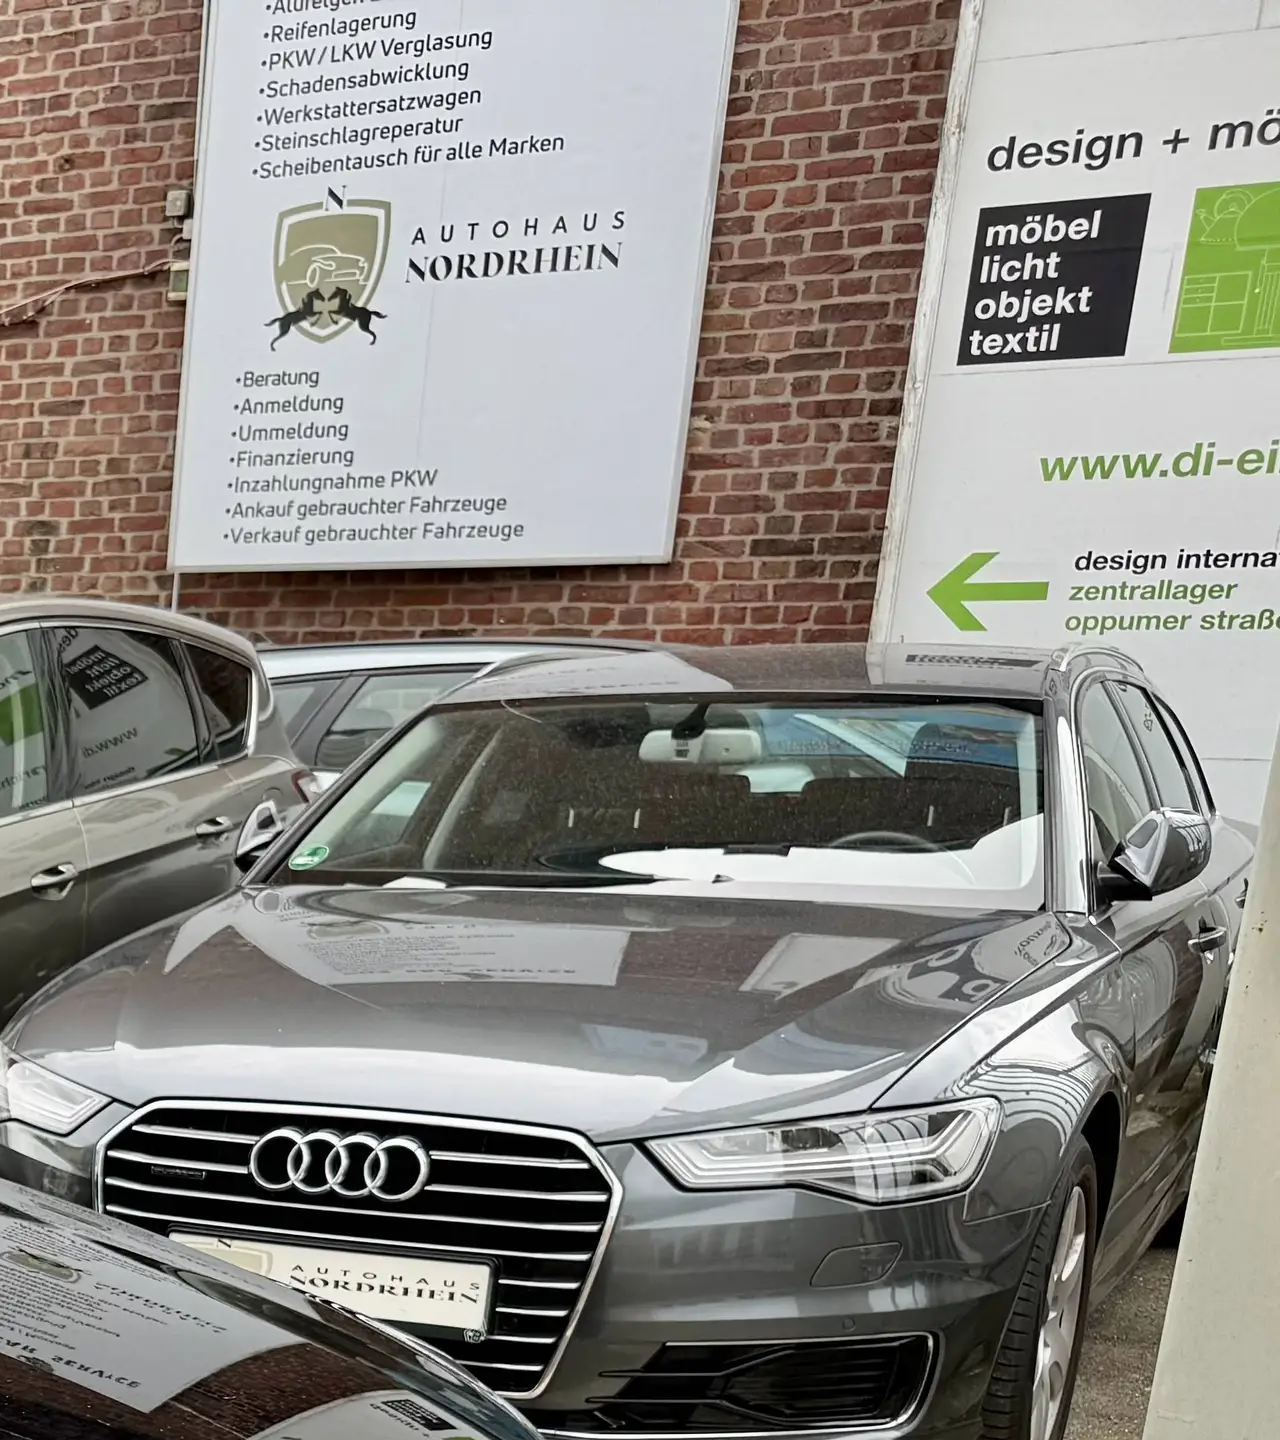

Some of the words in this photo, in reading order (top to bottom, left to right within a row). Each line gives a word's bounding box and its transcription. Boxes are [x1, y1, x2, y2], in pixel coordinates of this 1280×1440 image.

[271, 11, 417, 42] Reifenlagerung
[269, 51, 316, 71] PKW
[330, 41, 376, 63] LKW
[381, 30, 493, 57] Verglasung
[266, 61, 469, 98] Schadensabwicklung
[264, 89, 482, 125] Werkstattersatzwagen
[262, 116, 463, 151] Steinschlagreperatur
[259, 148, 408, 179] Scheibentausch
[414, 146, 442, 164] für
[446, 142, 482, 162] alle
[489, 135, 565, 157] Marken
[986, 130, 1143, 172] design
[411, 211, 625, 246] AUTOHAUS
[985, 210, 1103, 247] möbel
[405, 242, 623, 284] NORDRHEIN
[980, 251, 1061, 284] licht
[974, 285, 1093, 326] objekt
[969, 323, 1060, 357] textil
[243, 370, 320, 388] Beratung
[240, 396, 344, 415] Anmeldung
[239, 423, 348, 442] Ummeldung
[236, 449, 354, 468] Finanzierung
[1040, 439, 1280, 482] www.di-ei
[234, 472, 385, 494] Inzahlungnahme
[390, 469, 438, 488] PKW
[231, 501, 294, 519] Ankauf
[297, 498, 405, 521] gebrauchter
[409, 496, 507, 515] Fahrzeuge
[230, 526, 301, 544] Verkauf
[305, 524, 417, 546] gebrauchter
[422, 522, 524, 541] Fahrzeuge
[1075, 550, 1167, 575] design
[1177, 548, 1280, 569] interna
[1069, 579, 1238, 604] zentrallager
[1065, 613, 1192, 636] oppumer
[289, 1274, 478, 1304] NORDRHEIN
[291, 1264, 480, 1290] AUTOHAUS
